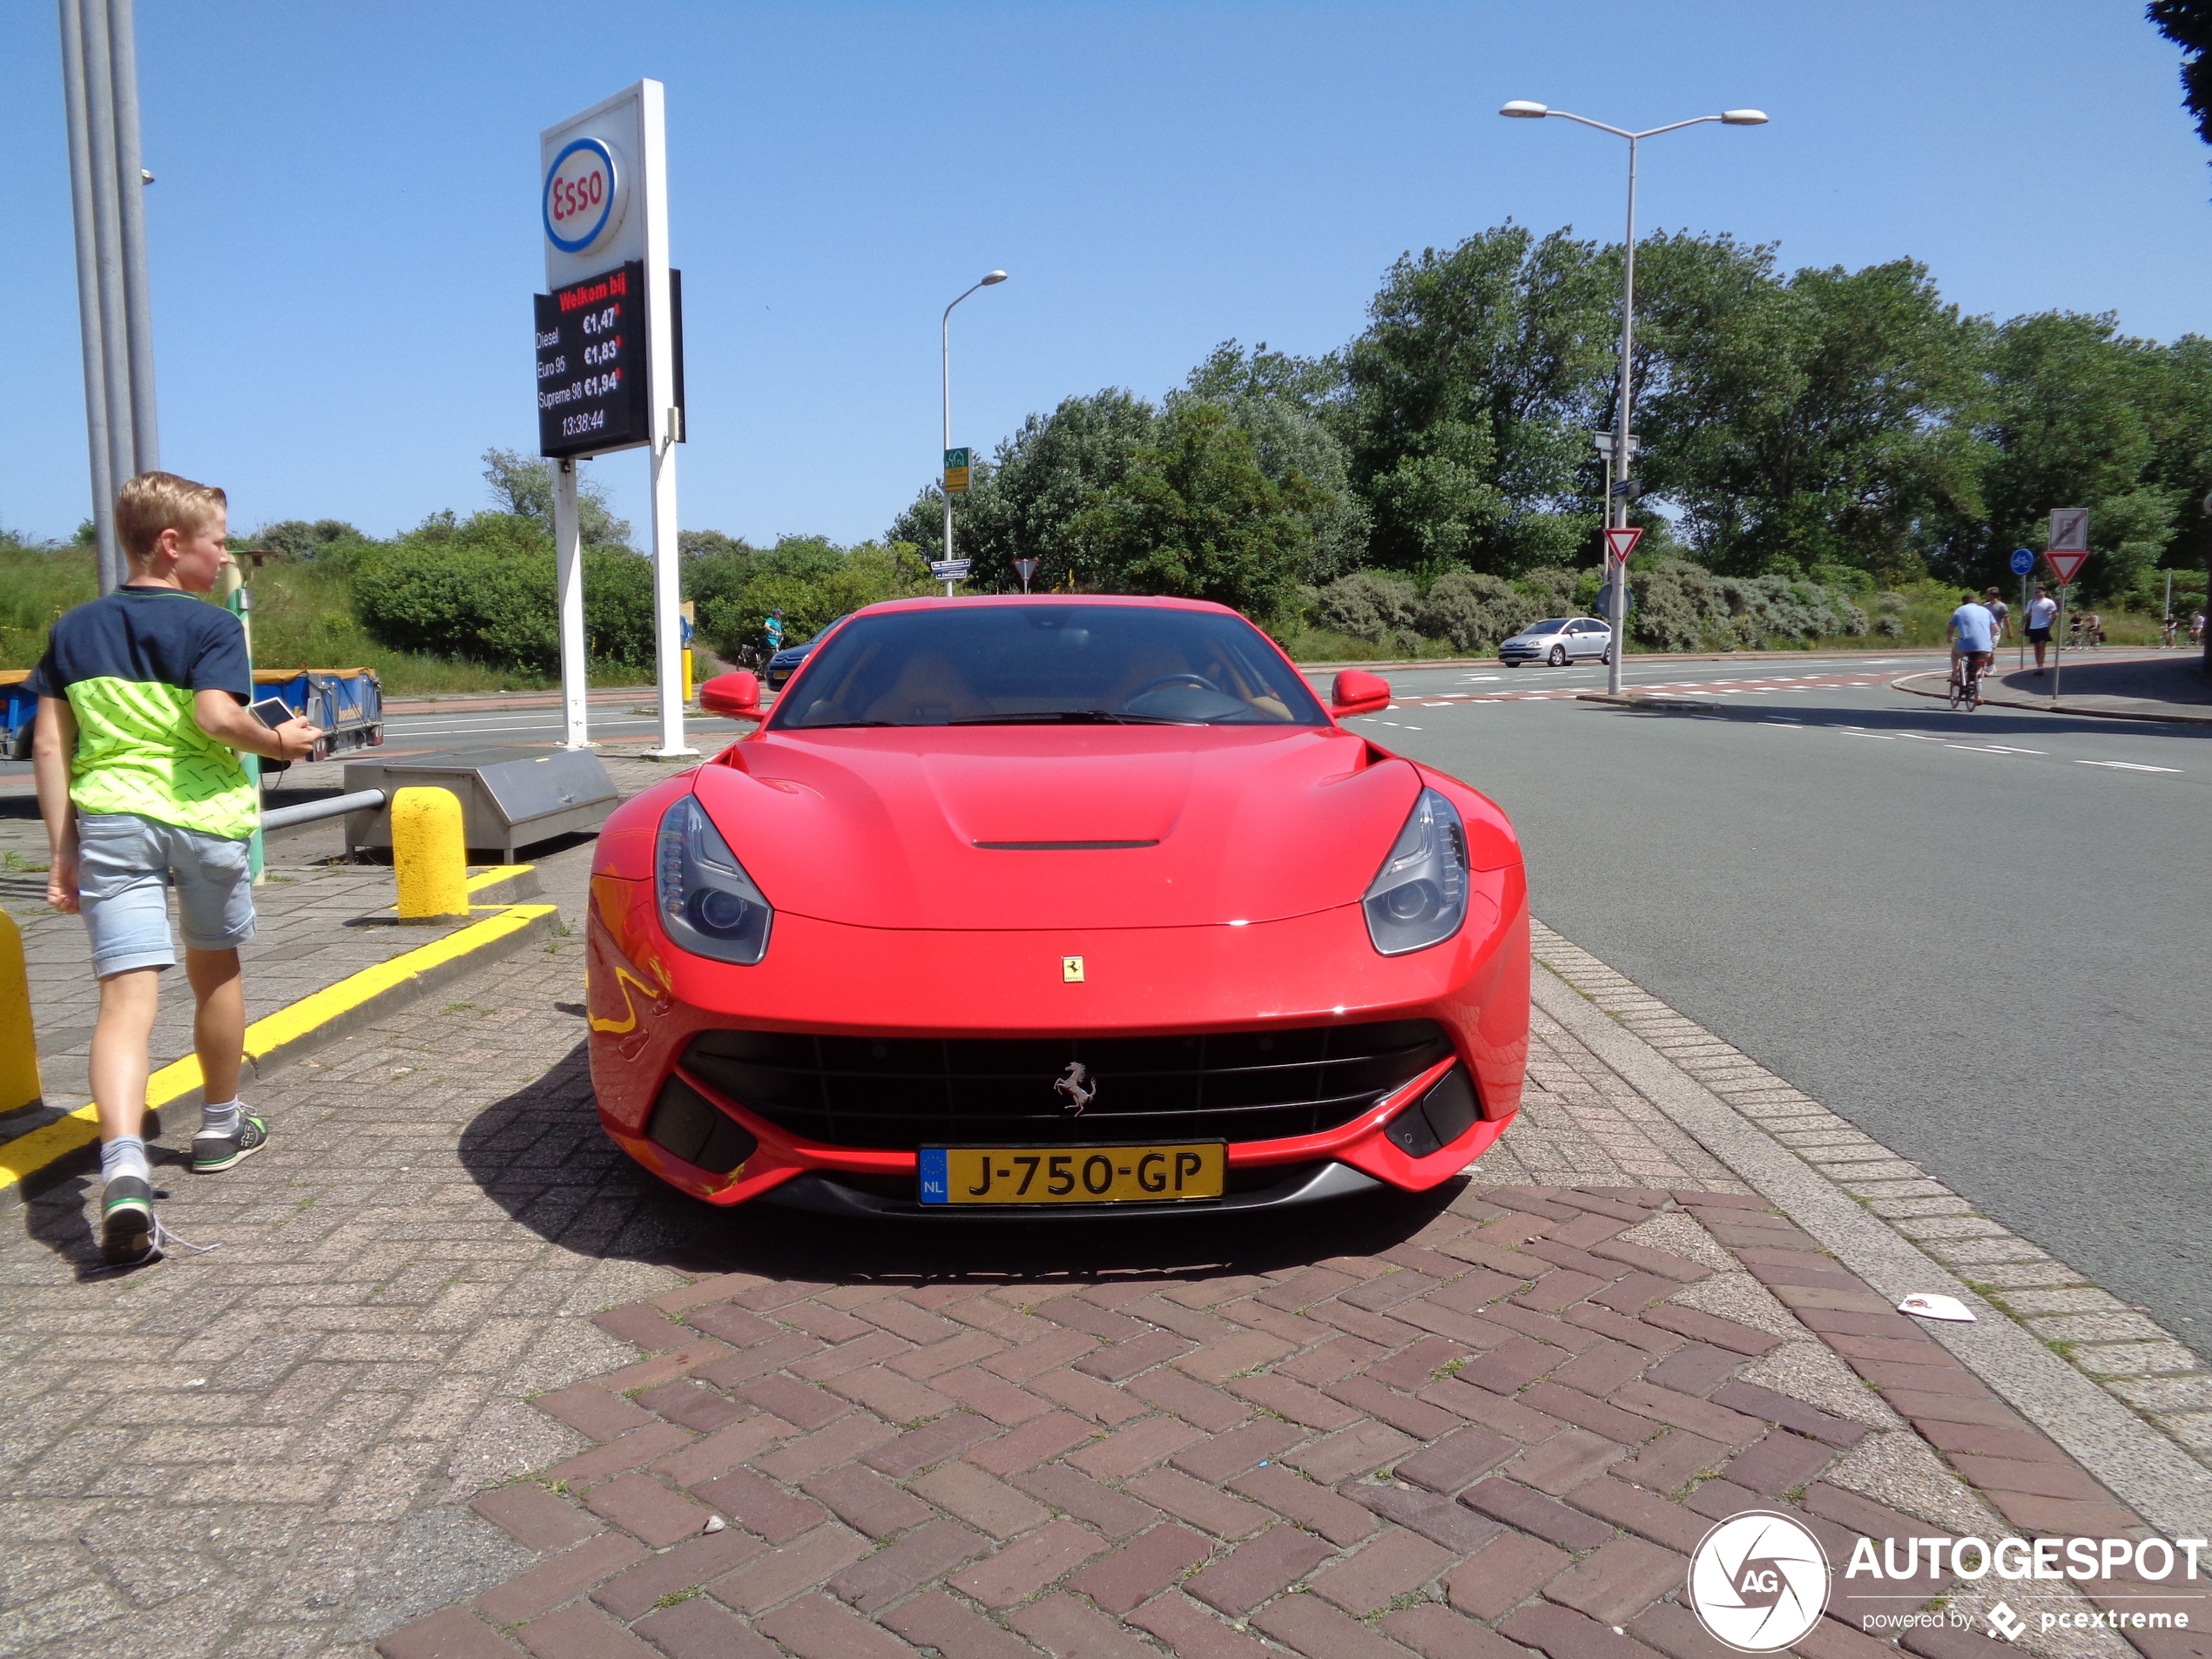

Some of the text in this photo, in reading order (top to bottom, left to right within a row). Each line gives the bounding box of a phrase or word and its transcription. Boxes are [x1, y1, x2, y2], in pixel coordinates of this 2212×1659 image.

[559, 272, 626, 312] Welkom bij
[536, 327, 558, 349] Diesel
[537, 361, 554, 379] Euro
[555, 355, 565, 374] 95
[538, 388, 570, 410] Supreme
[571, 381, 582, 400] 98
[562, 408, 604, 436] 13:38:44
[924, 1152, 1202, 1196] NL J-750-GP
